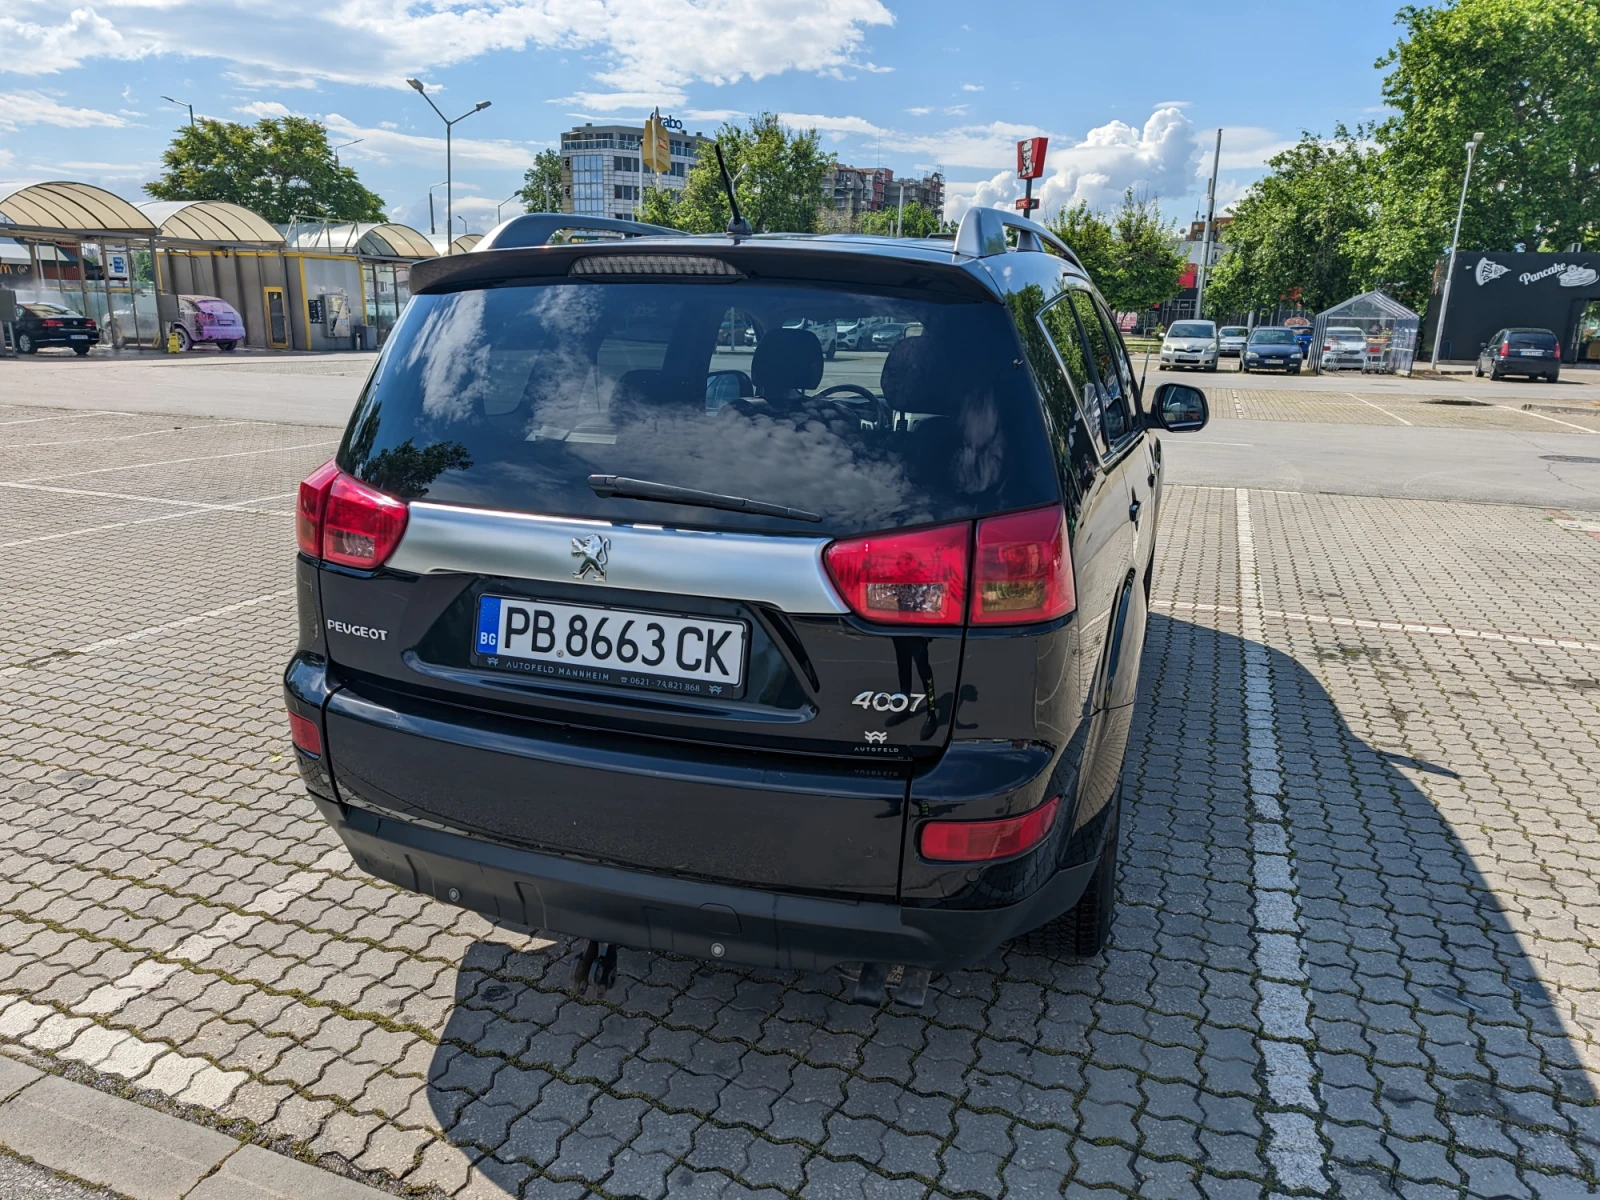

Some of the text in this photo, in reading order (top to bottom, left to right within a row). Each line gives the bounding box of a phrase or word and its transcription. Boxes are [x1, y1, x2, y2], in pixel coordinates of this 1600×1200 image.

[1482, 262, 1495, 282] PIZZA
[1519, 263, 1567, 285] Pancake
[327, 619, 388, 641] PEUGEOT
[480, 606, 732, 676] BG PB 8663 CK
[506, 661, 609, 681] AUTOFELD MANNHEIM
[630, 676, 649, 686] 0621
[684, 682, 700, 692] 868
[851, 691, 926, 712] 4007
